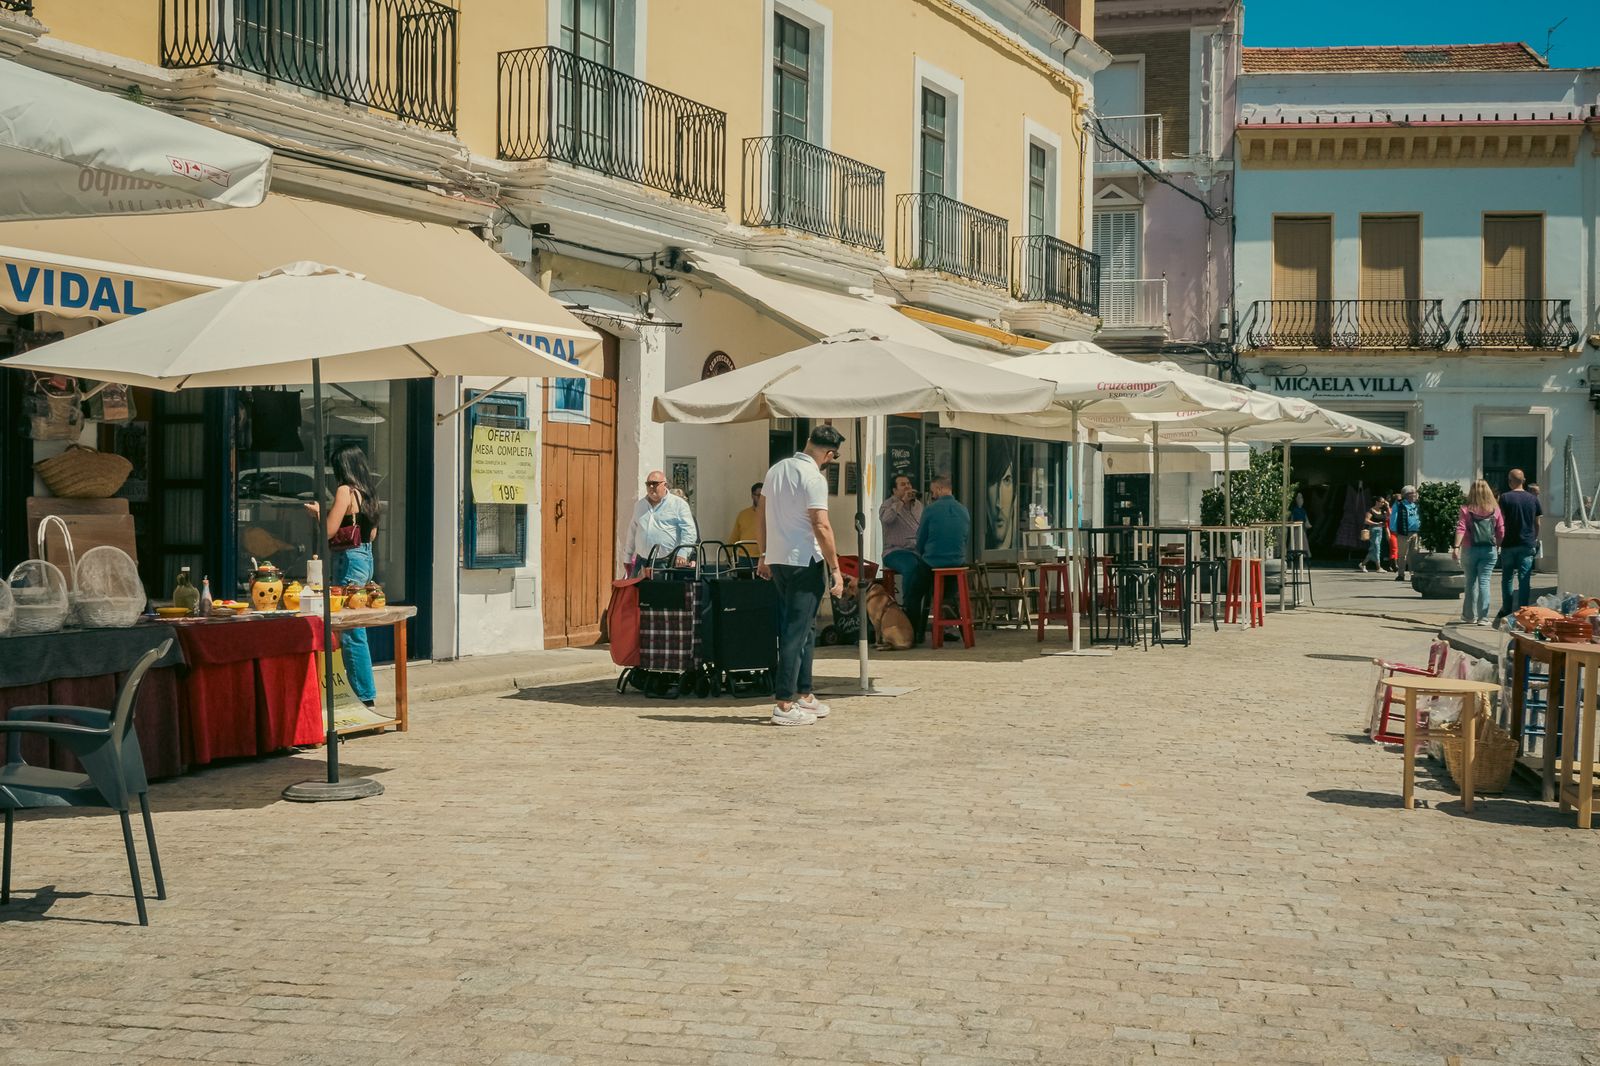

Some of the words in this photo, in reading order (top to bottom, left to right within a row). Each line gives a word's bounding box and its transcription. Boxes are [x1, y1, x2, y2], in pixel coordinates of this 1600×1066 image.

[5, 263, 147, 315] VIDAL
[1097, 381, 1157, 391] Cruzcampo
[1275, 377, 1355, 391] MICAELA
[1359, 377, 1414, 392] VILLA
[488, 429, 521, 443] OFERTA
[475, 444, 494, 455] MESA
[497, 445, 533, 457] COMPLETA
